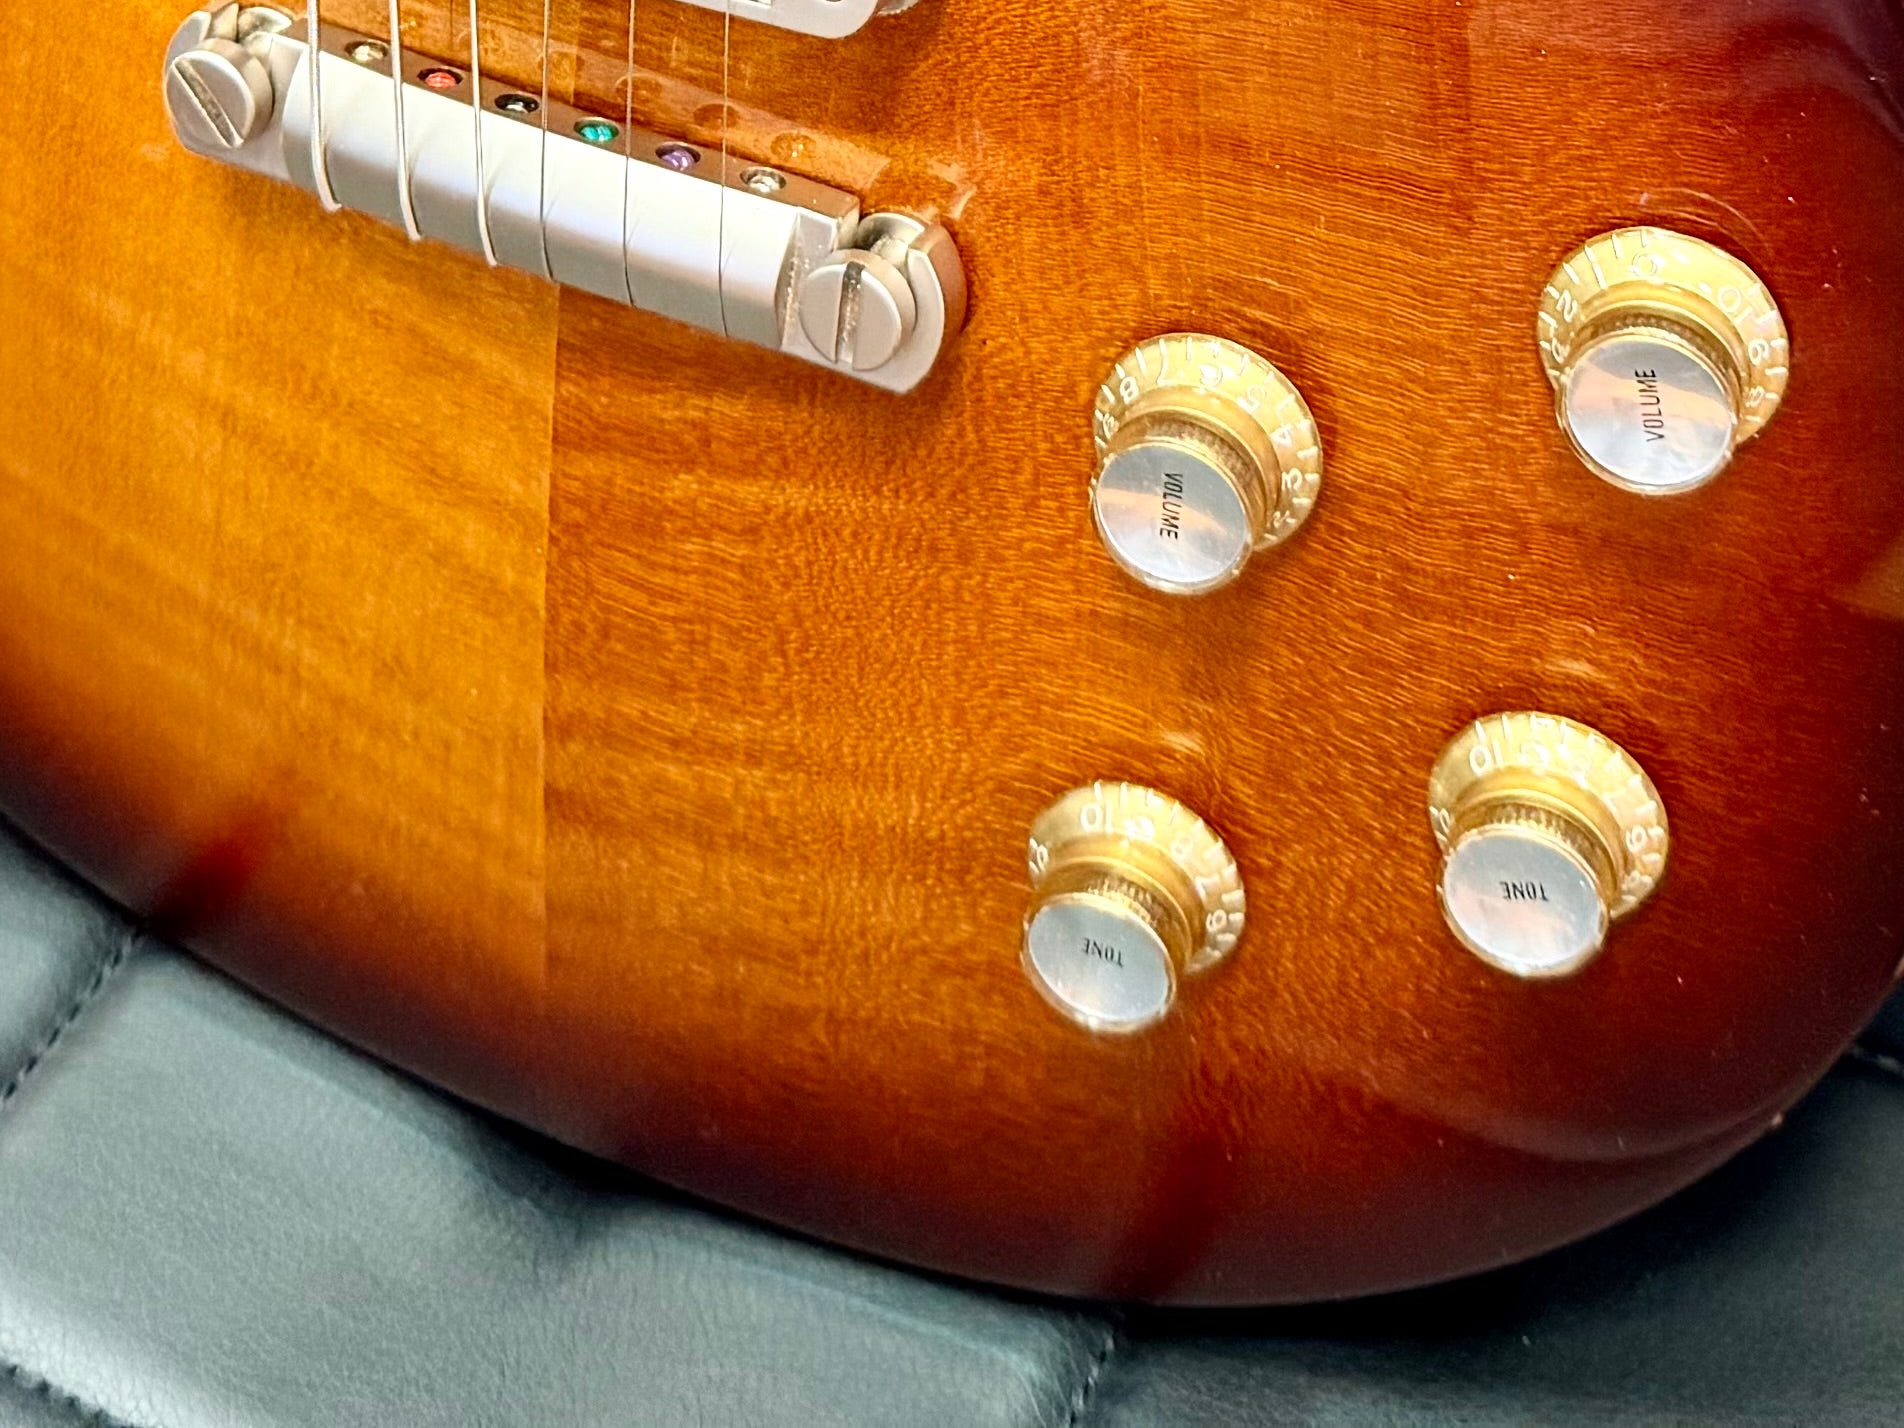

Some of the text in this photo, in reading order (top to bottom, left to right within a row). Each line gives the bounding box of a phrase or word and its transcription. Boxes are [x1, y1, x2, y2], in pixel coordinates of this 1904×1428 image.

[1718, 285, 1753, 323] 10
[1119, 376, 1139, 405] 8
[1634, 368, 1665, 443] VOLUME
[1159, 472, 1183, 541] VOLUME
[1469, 737, 1504, 777] 10
[1080, 802, 1114, 834] 10
[1499, 881, 1550, 902] TONE
[1081, 937, 1124, 969] TONE
